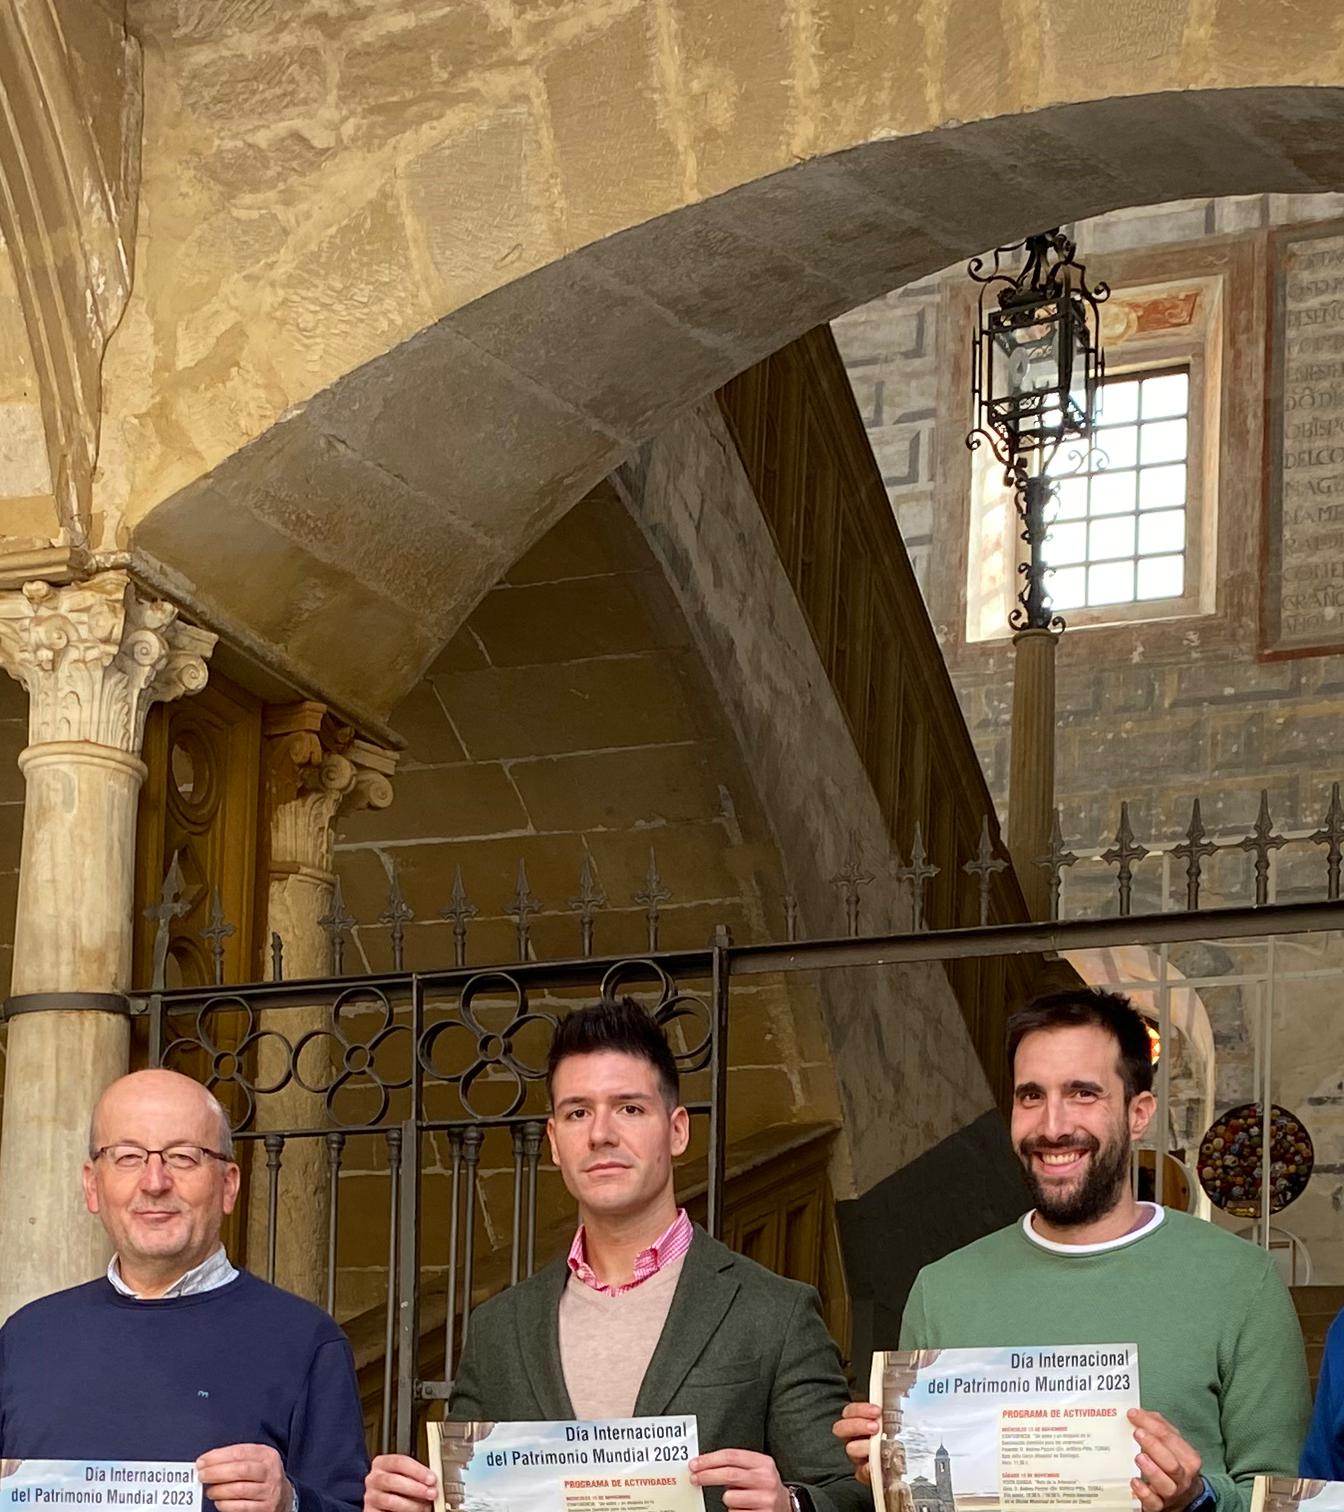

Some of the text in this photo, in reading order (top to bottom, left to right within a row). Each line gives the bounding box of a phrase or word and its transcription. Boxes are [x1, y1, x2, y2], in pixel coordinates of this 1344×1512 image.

[1011, 1350, 1129, 1369] Día Internacional
[928, 1374, 1130, 1394] del Patrimonio Mundial 2023
[1002, 1408, 1117, 1418] PROGRAMA DE ACTIVIDADES
[566, 1422, 687, 1442] Día Internacional
[487, 1445, 689, 1466] del Patrimonio Mundial 2023
[85, 1466, 194, 1483] Día Internacional
[564, 1477, 677, 1489] PROGRAMA DE ACTIVIDADES
[11, 1487, 193, 1506] del Patrimonio Mundial 2023
